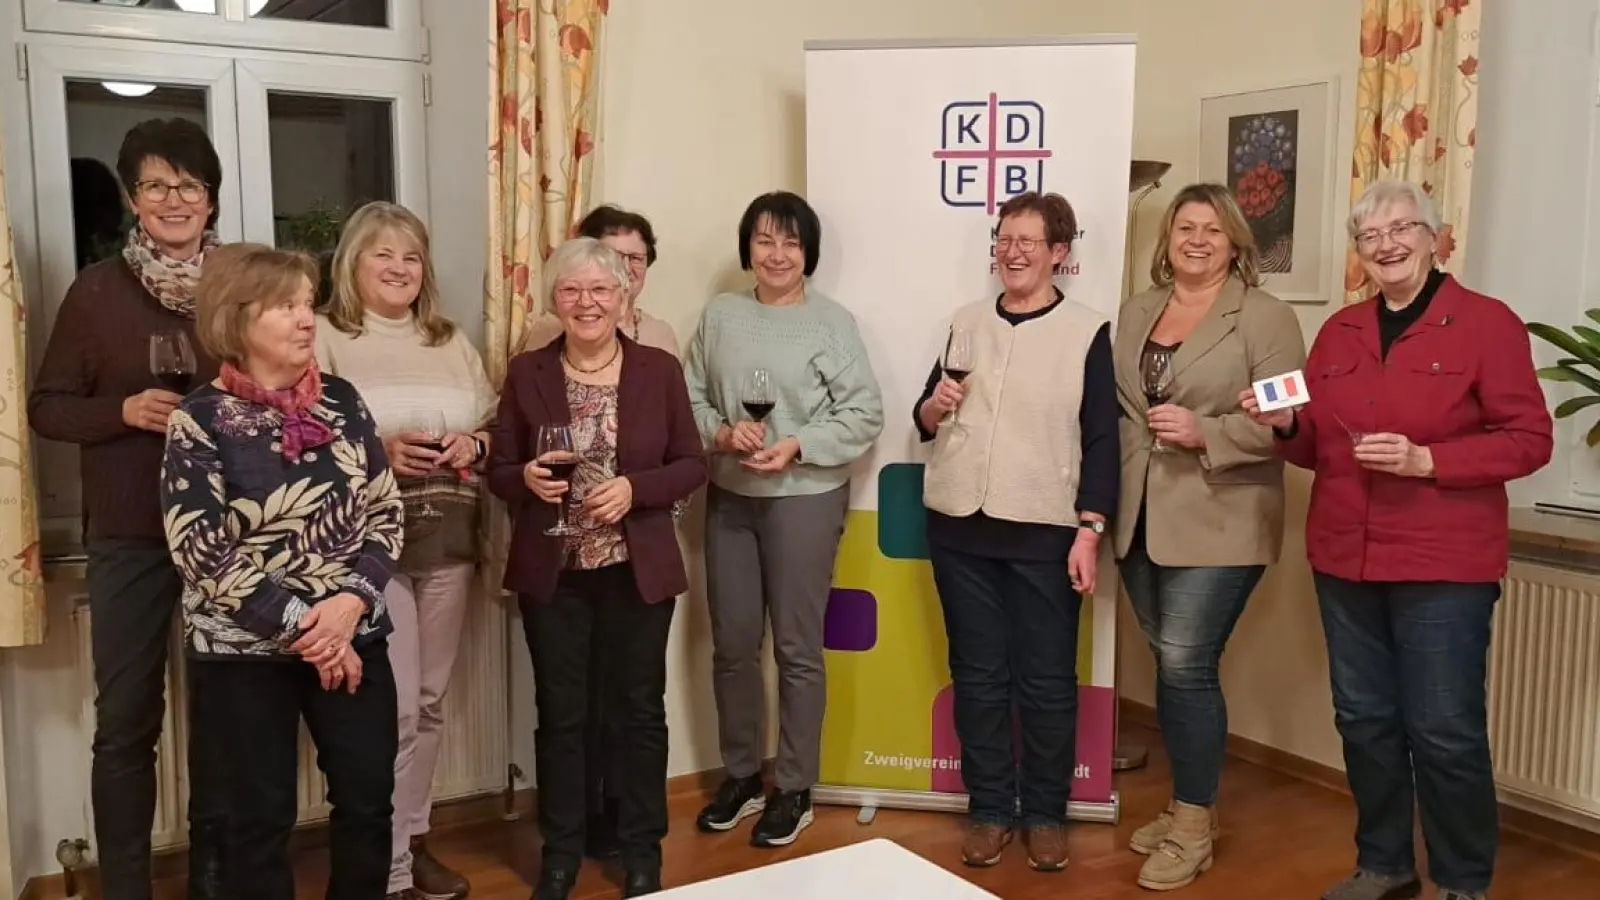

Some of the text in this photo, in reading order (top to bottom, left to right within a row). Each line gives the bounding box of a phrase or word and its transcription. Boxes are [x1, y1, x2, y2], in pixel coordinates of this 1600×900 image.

[957, 113, 1030, 144] K D
[956, 165, 1028, 195] F B
